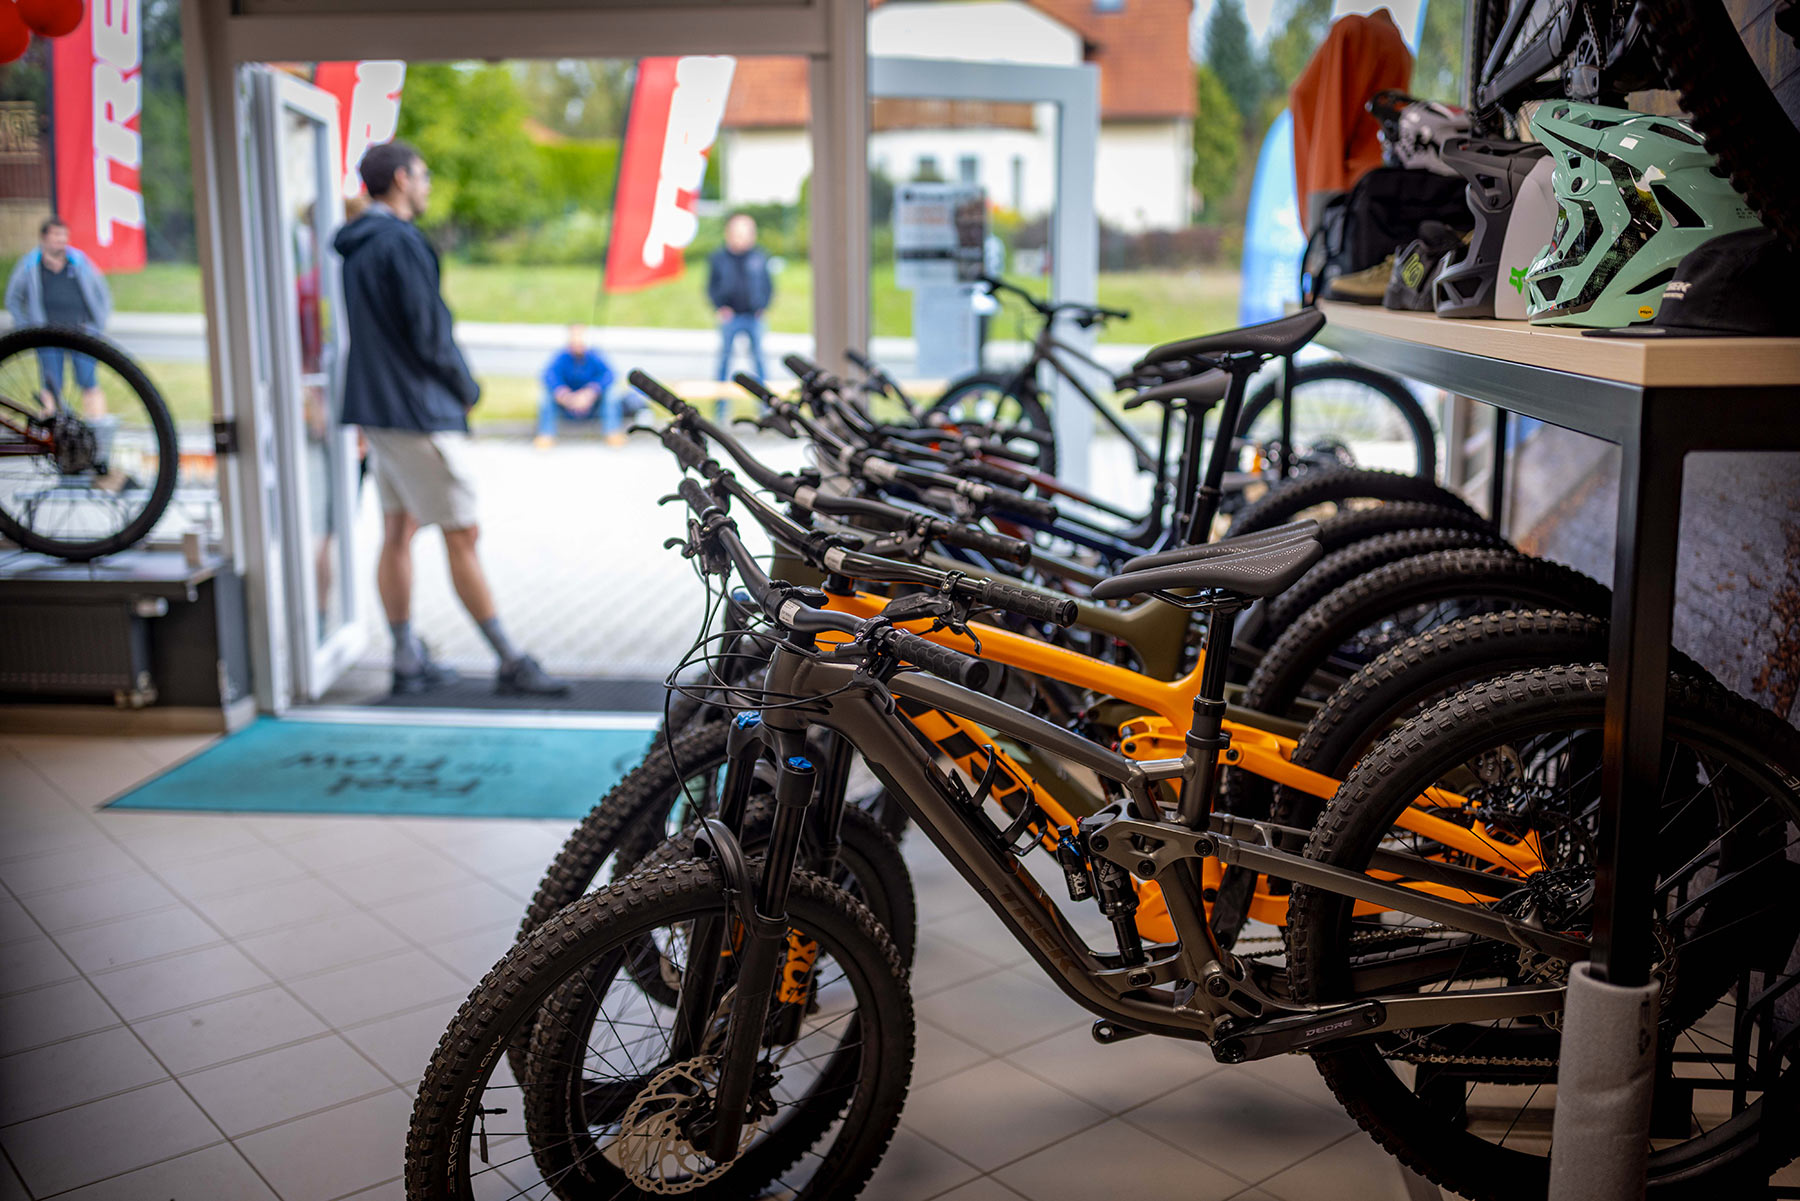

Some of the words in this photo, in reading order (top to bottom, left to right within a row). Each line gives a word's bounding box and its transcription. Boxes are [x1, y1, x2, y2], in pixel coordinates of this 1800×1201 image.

[1072, 871, 1088, 895] FOX
[1001, 884, 1081, 974] TREK
[777, 927, 817, 1005] FOX
[1305, 1019, 1353, 1037] DEORE
[455, 1076, 479, 1125] TEAM
[447, 1126, 462, 1176] ISSUE
